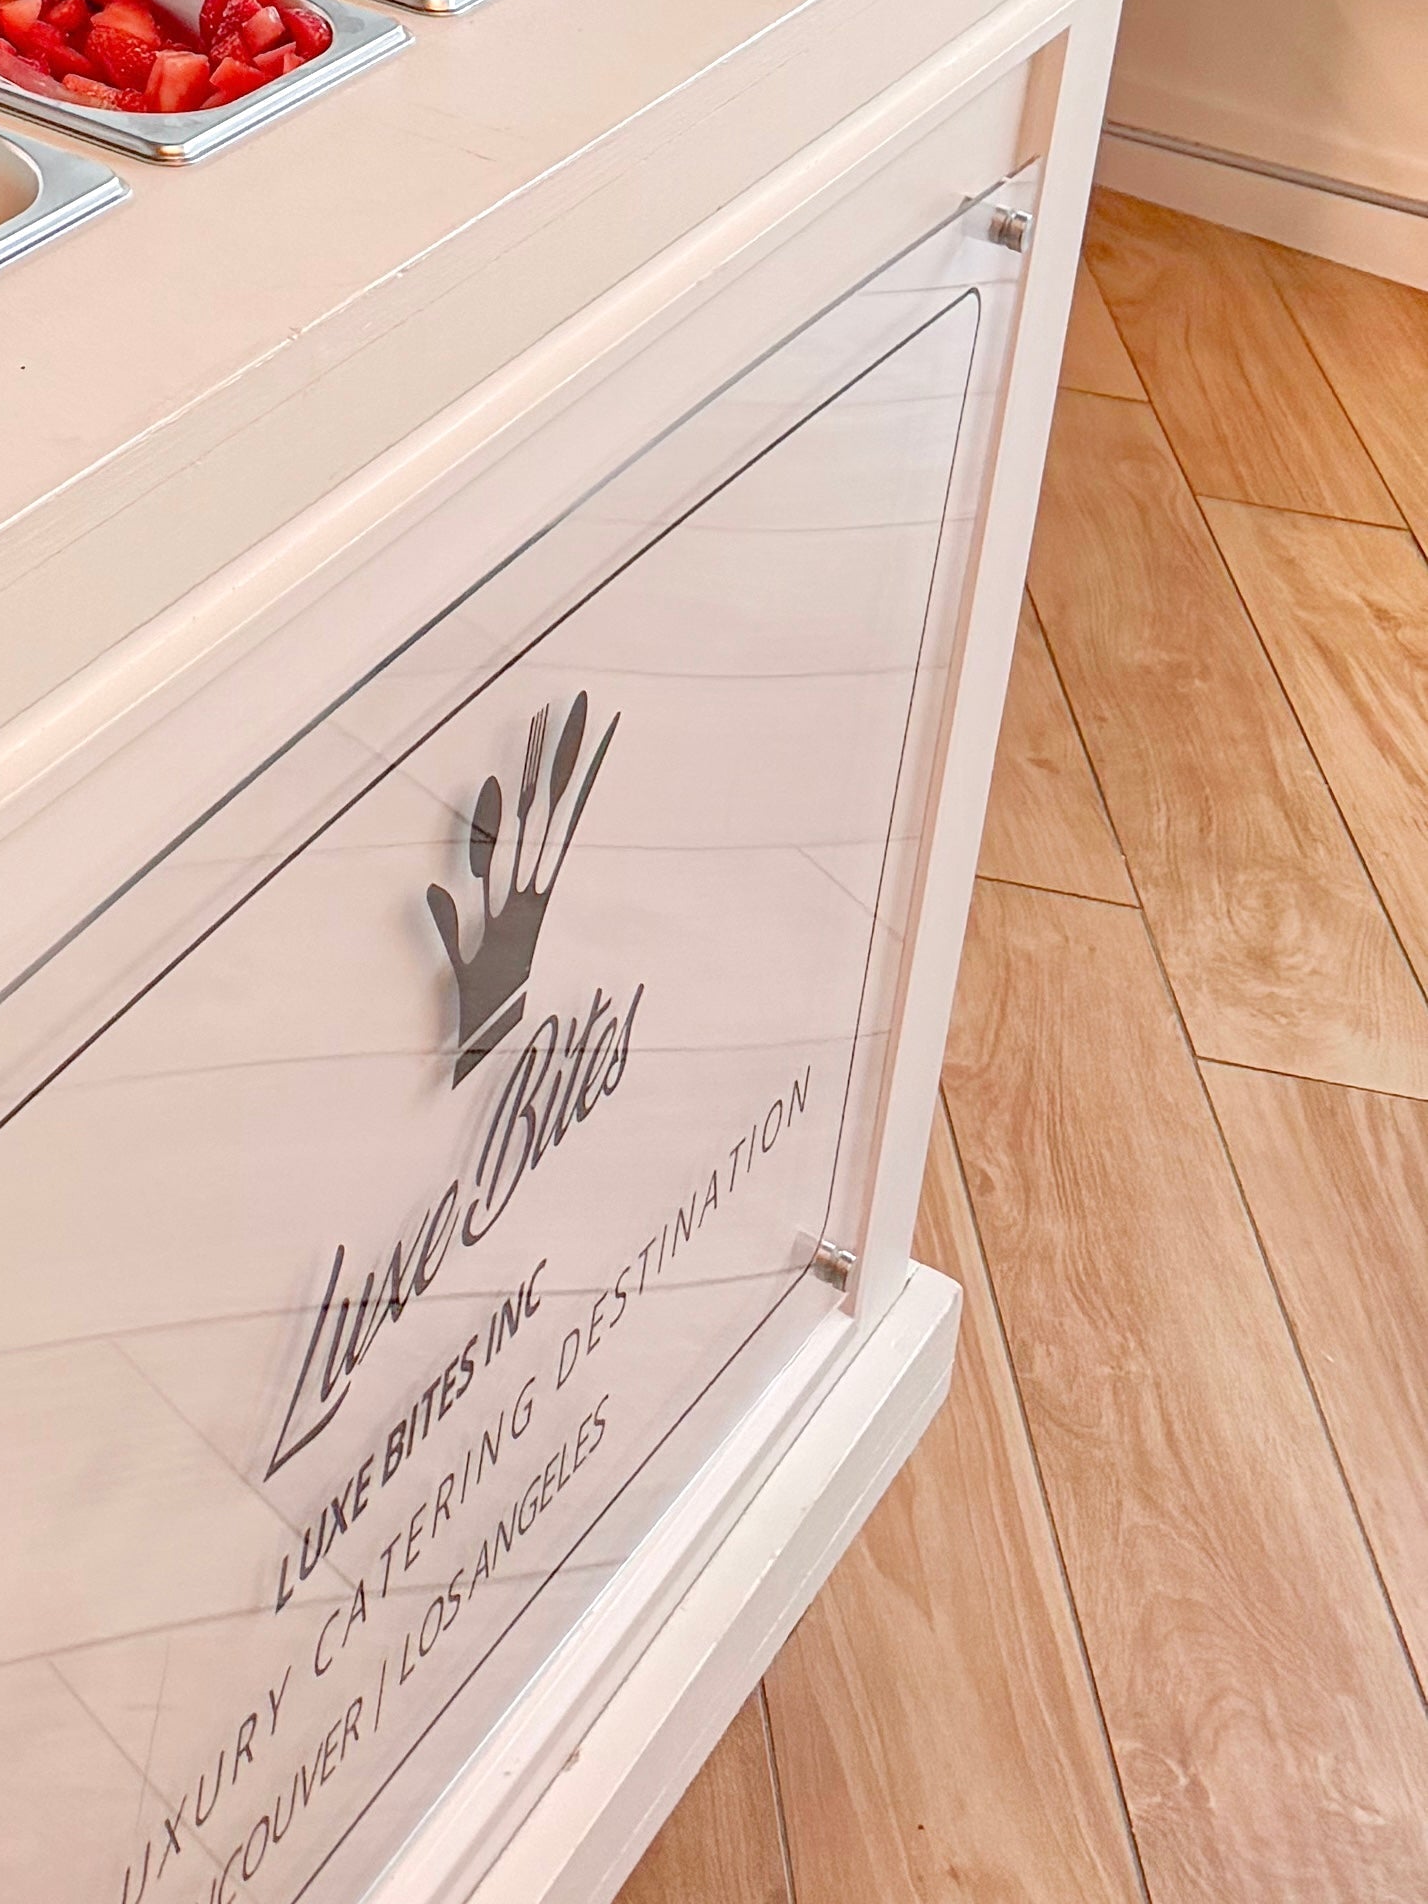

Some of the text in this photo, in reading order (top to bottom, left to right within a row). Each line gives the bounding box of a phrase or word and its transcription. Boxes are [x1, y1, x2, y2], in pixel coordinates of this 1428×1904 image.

[263, 982, 645, 1483] Luxe Bites
[275, 1257, 547, 1614] LUXE BITES INC
[314, 1376, 537, 1678] CATERING
[556, 1064, 811, 1391] DESTINATION
[399, 1567, 464, 1686] LOS
[468, 1393, 609, 1601] ANGELES
